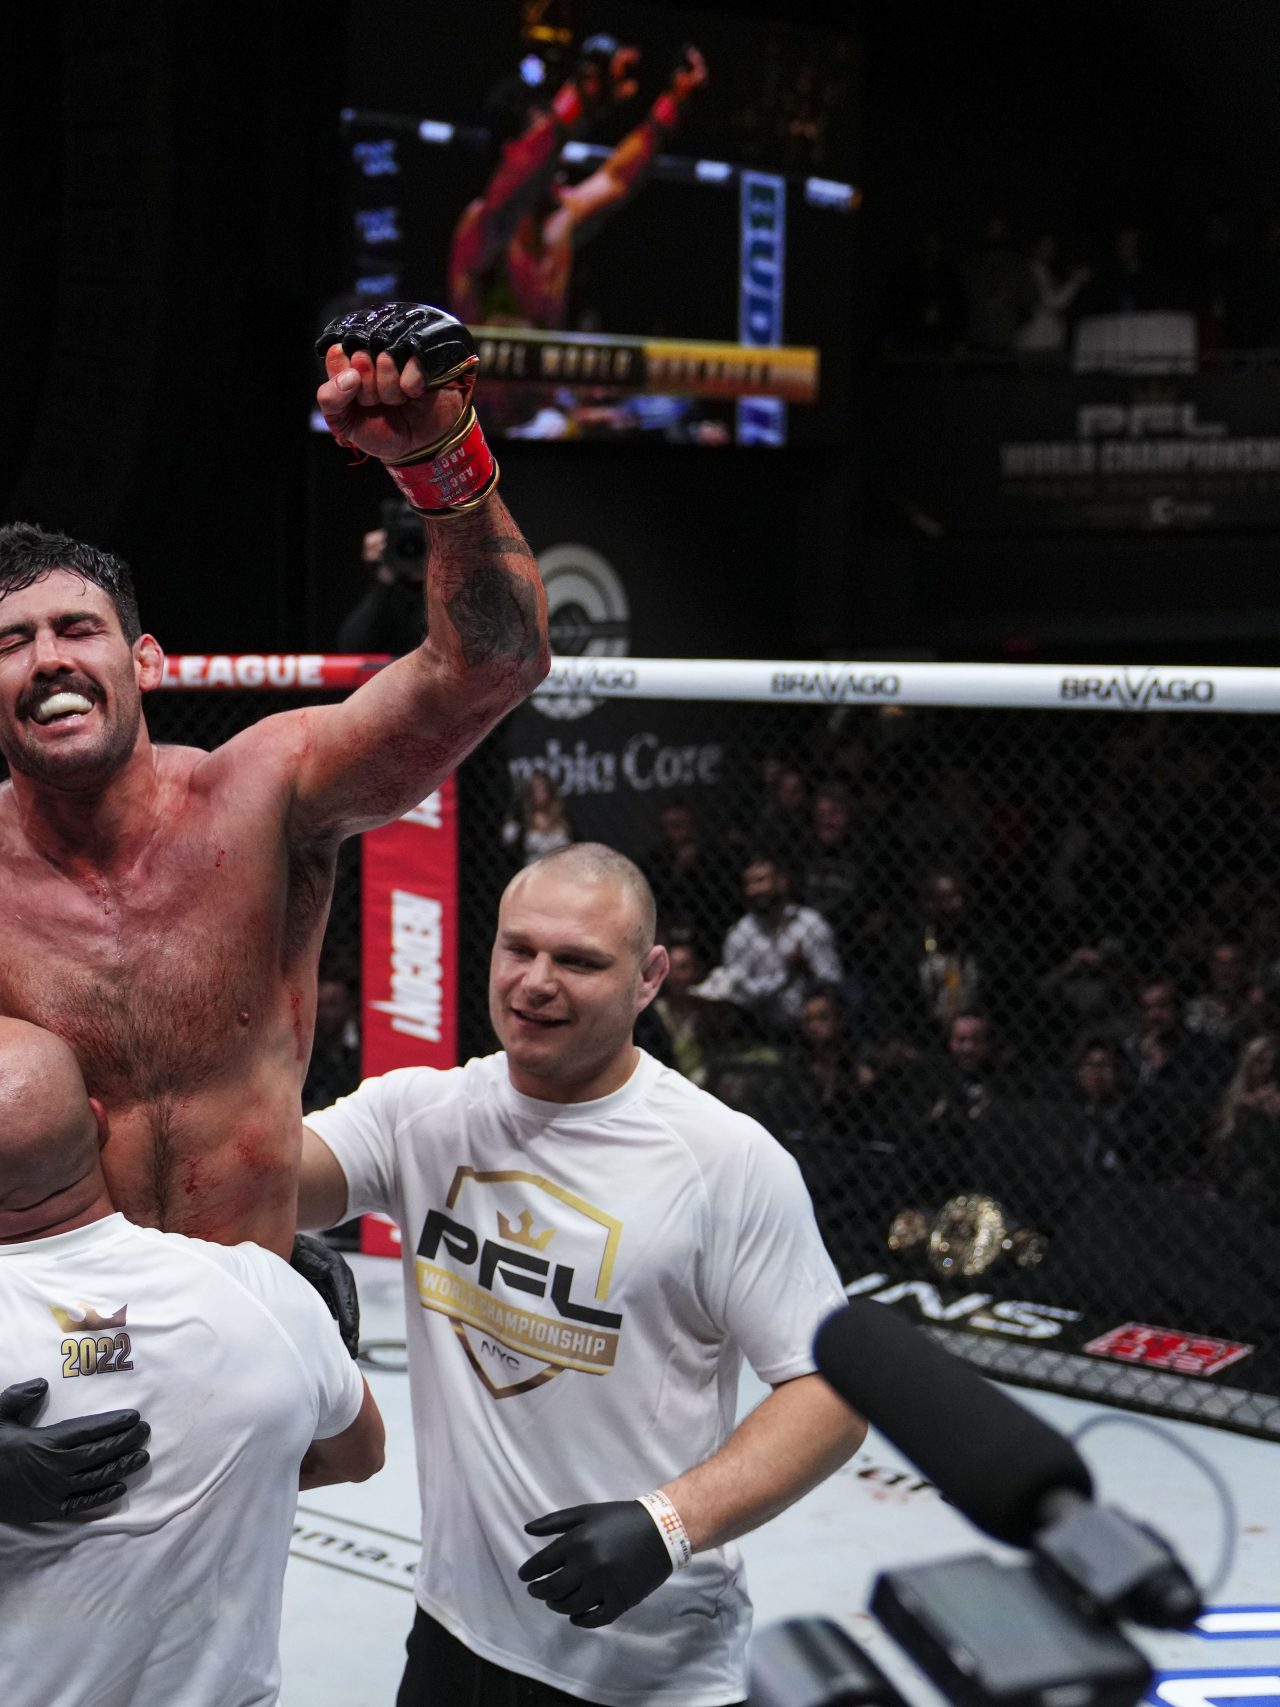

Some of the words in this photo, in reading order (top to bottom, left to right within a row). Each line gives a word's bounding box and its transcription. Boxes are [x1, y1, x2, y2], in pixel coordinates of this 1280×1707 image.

[161, 655, 325, 687] LEAGUE
[1060, 668, 1214, 710] BRAVAGO
[508, 738, 617, 796] mbia
[622, 733, 723, 791] Care
[416, 1209, 622, 1329] PFL
[480, 1300, 606, 1356] CHAMPIONSHIP
[61, 1332, 134, 1378] 2022
[480, 1340, 520, 1371] NYC
